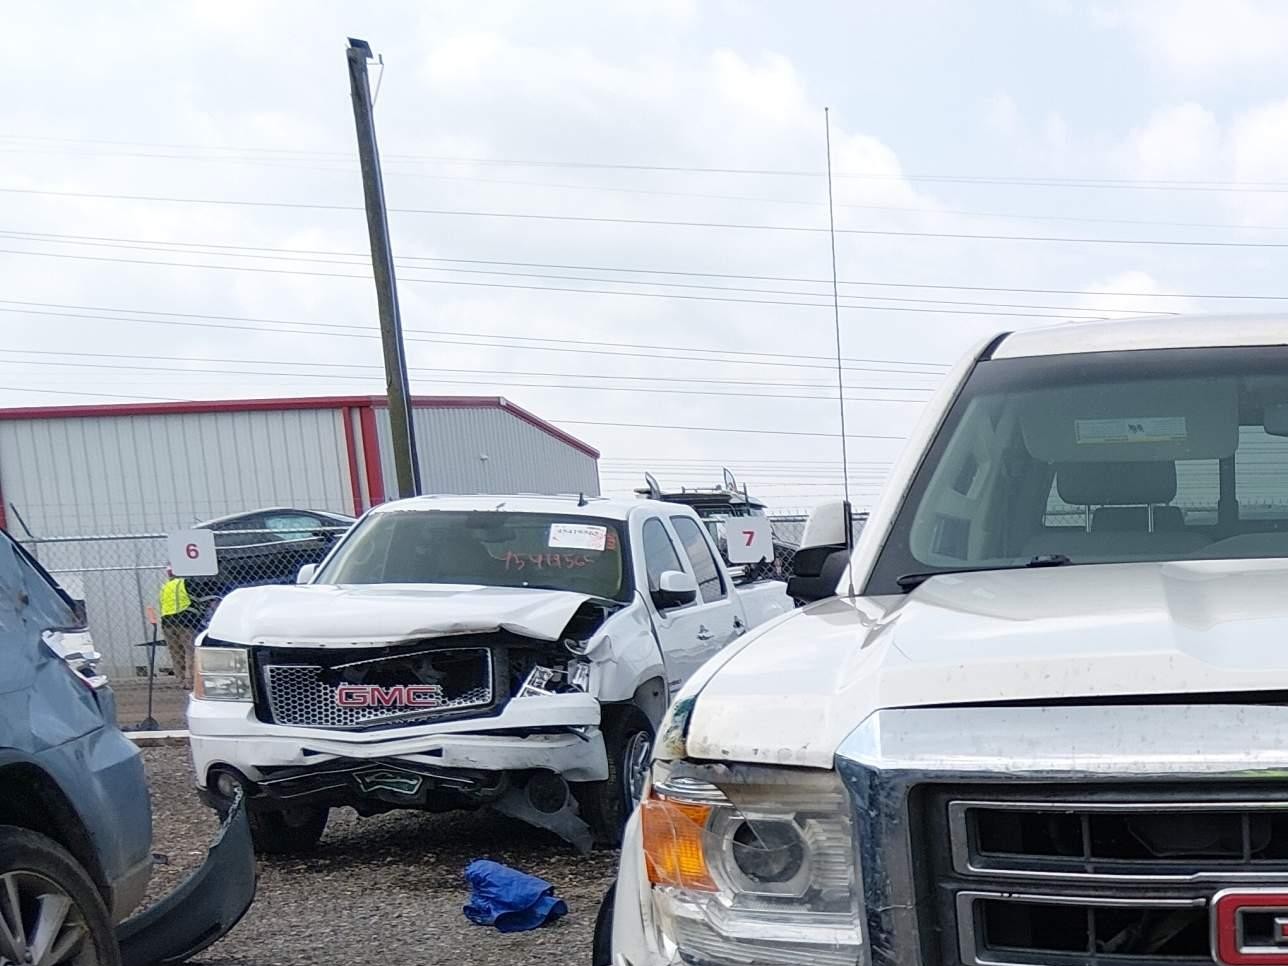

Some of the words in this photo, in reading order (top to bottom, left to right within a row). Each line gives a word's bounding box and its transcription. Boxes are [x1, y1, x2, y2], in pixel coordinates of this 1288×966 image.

[742, 530, 755, 547] 7
[185, 543, 200, 560] 6
[336, 684, 439, 707] GMC
